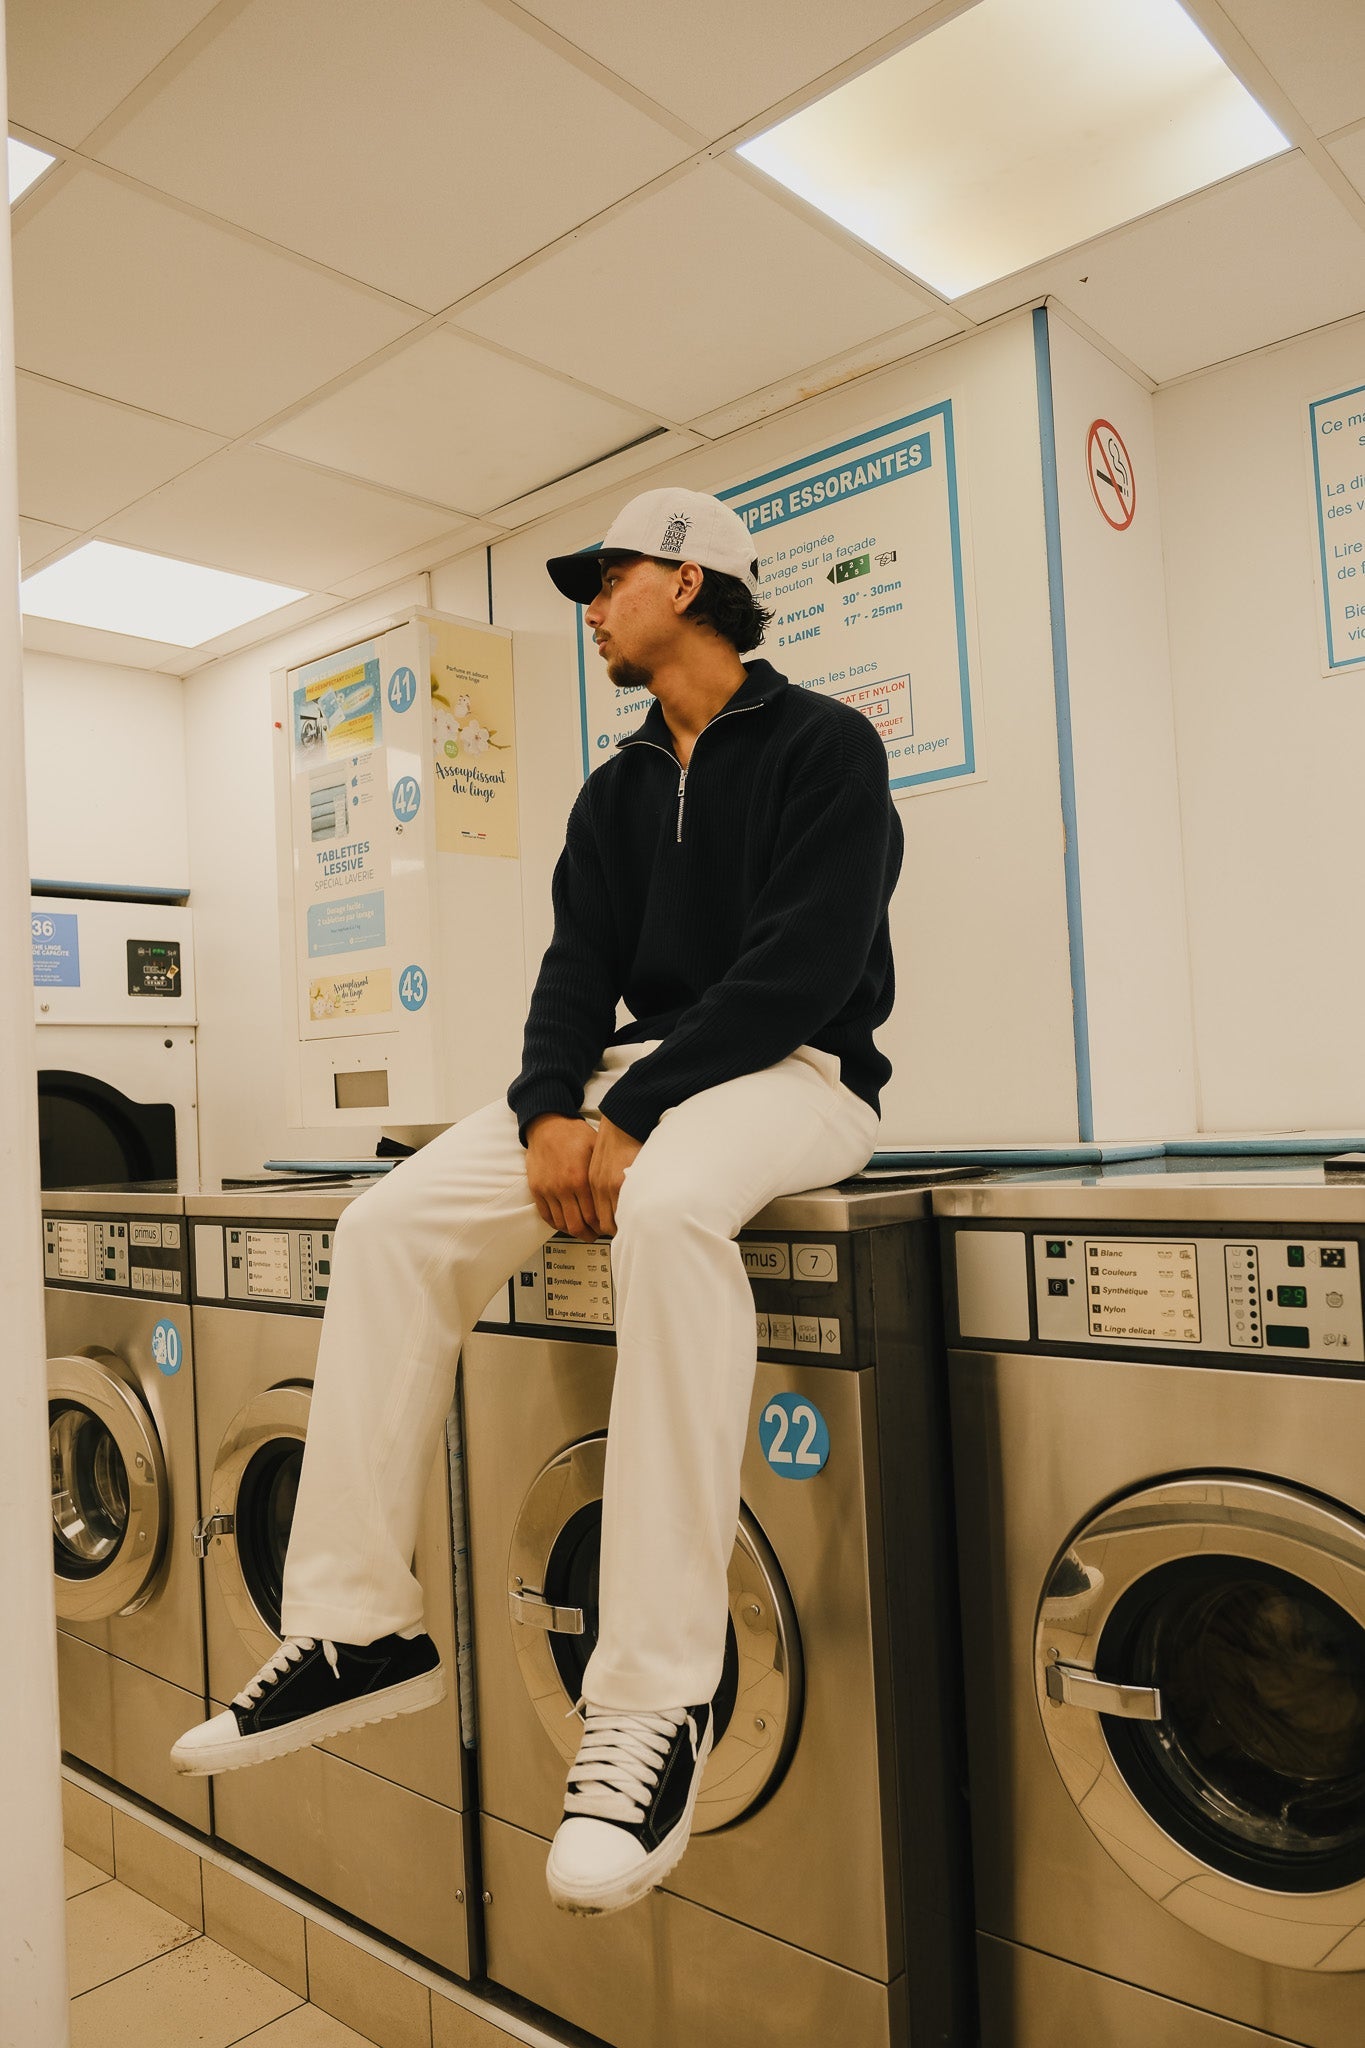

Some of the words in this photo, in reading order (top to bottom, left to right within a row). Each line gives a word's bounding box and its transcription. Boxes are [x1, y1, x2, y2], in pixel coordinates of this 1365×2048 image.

[1321, 420, 1343, 435] Ce
[789, 444, 923, 513] ESSORANTES
[1326, 483, 1345, 497] La
[1327, 504, 1353, 519] des
[776, 551, 787, 562] la
[789, 533, 835, 558] poignée
[1334, 542, 1363, 559] Lire
[758, 566, 799, 586] Lavage
[801, 557, 819, 570] sur
[822, 552, 833, 564] la
[836, 536, 876, 558] façade
[1337, 566, 1356, 580] de
[774, 576, 813, 597] bouton
[777, 616, 784, 627] 4
[787, 603, 826, 625] NYLON
[842, 591, 861, 606] 30°
[869, 580, 902, 598] 30mn
[778, 637, 785, 647] 5
[788, 625, 822, 645] LAINE
[843, 612, 861, 627] 17°
[871, 601, 904, 619] 25mn
[828, 669, 846, 682] les
[849, 661, 878, 676] bacs
[390, 670, 411, 705] 41
[615, 689, 621, 698] 2
[858, 690, 871, 701] ET
[872, 680, 906, 698] NYLON
[616, 707, 622, 717] 3
[876, 703, 884, 714] 5
[875, 716, 904, 729] PAQUET
[904, 744, 915, 756] et
[917, 737, 950, 754] payer
[435, 761, 505, 785] Assouplissant
[395, 780, 417, 815] 42
[452, 778, 467, 795] du
[469, 782, 495, 803] linge
[316, 841, 370, 864] TABLETTES
[324, 857, 364, 876] LESSIVE
[345, 868, 374, 886] LAVERIE
[32, 919, 53, 937] 36
[401, 970, 424, 1002] 43
[134, 1227, 157, 1240] primus
[168, 1230, 173, 1240] 7
[810, 1255, 819, 1270] 7
[1100, 1249, 1123, 1258] Blanc
[1101, 1268, 1137, 1277] Couleurs
[553, 1278, 582, 1286] Synthétique
[1102, 1286, 1149, 1296] Synthétique
[554, 1293, 569, 1301] Nylon
[1103, 1305, 1126, 1315] Nylon
[1104, 1324, 1127, 1335] Linge
[1128, 1326, 1156, 1336] delicat
[765, 1403, 822, 1466] 22
